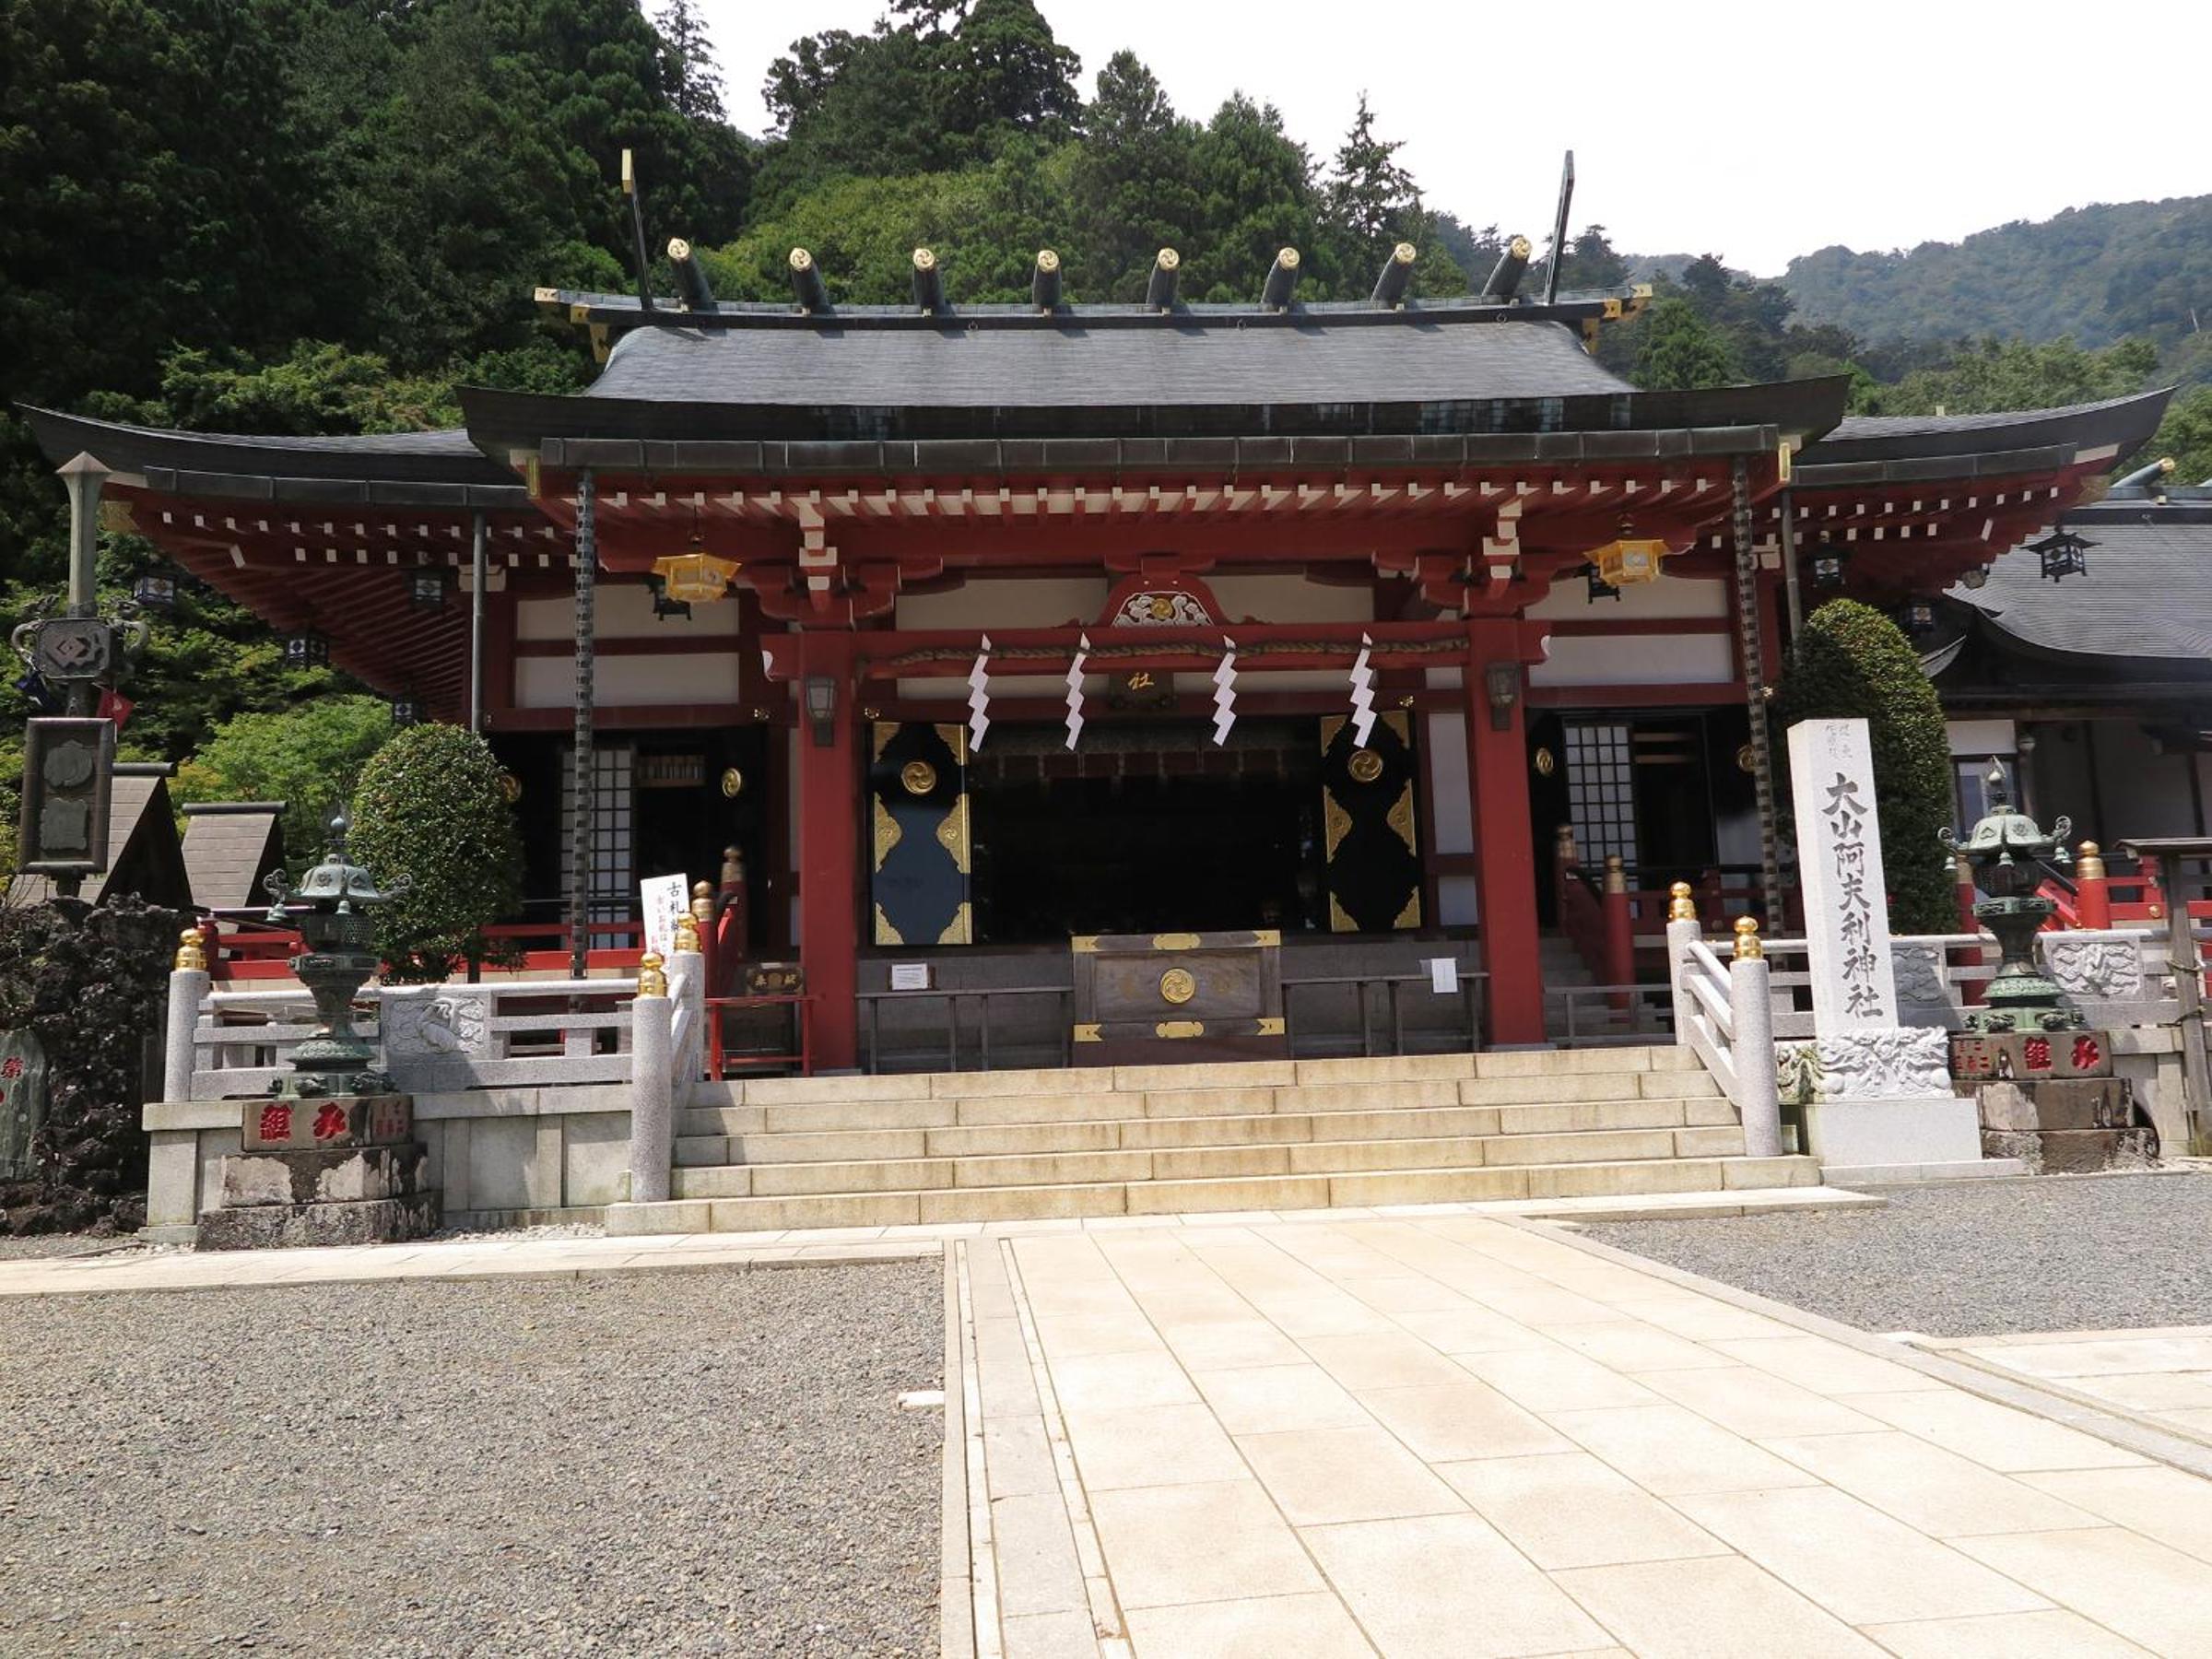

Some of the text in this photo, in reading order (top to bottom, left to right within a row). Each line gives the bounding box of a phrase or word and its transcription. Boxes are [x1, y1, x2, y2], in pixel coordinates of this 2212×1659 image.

[1821, 772, 1883, 1018] 大山阿夫利神社
